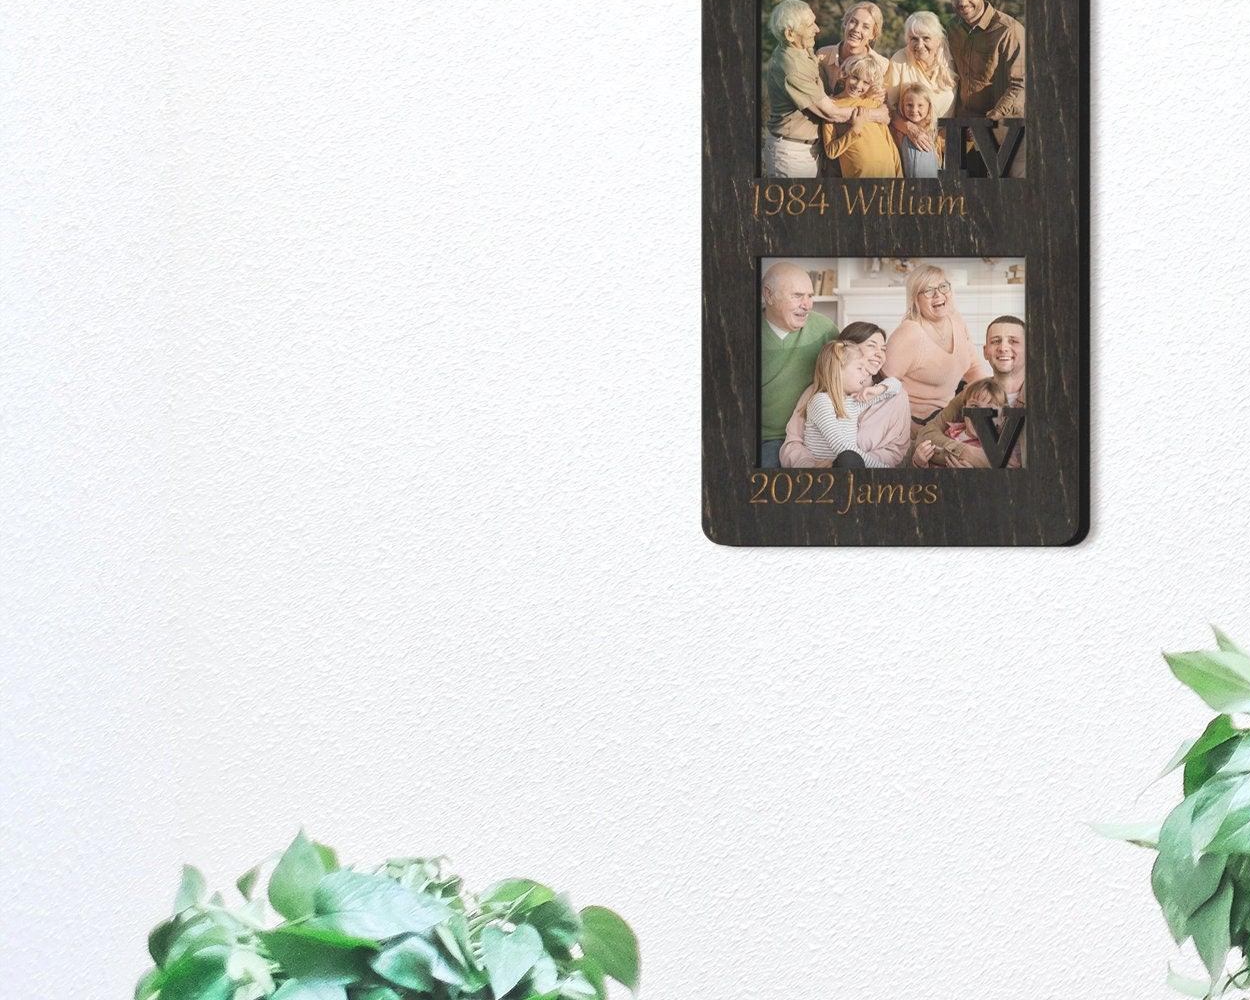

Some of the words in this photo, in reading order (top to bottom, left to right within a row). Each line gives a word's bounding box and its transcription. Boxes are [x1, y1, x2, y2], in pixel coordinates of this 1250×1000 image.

[751, 183, 830, 217] 1984
[842, 180, 968, 217] William
[750, 472, 836, 504] 2022
[837, 471, 939, 515] James
